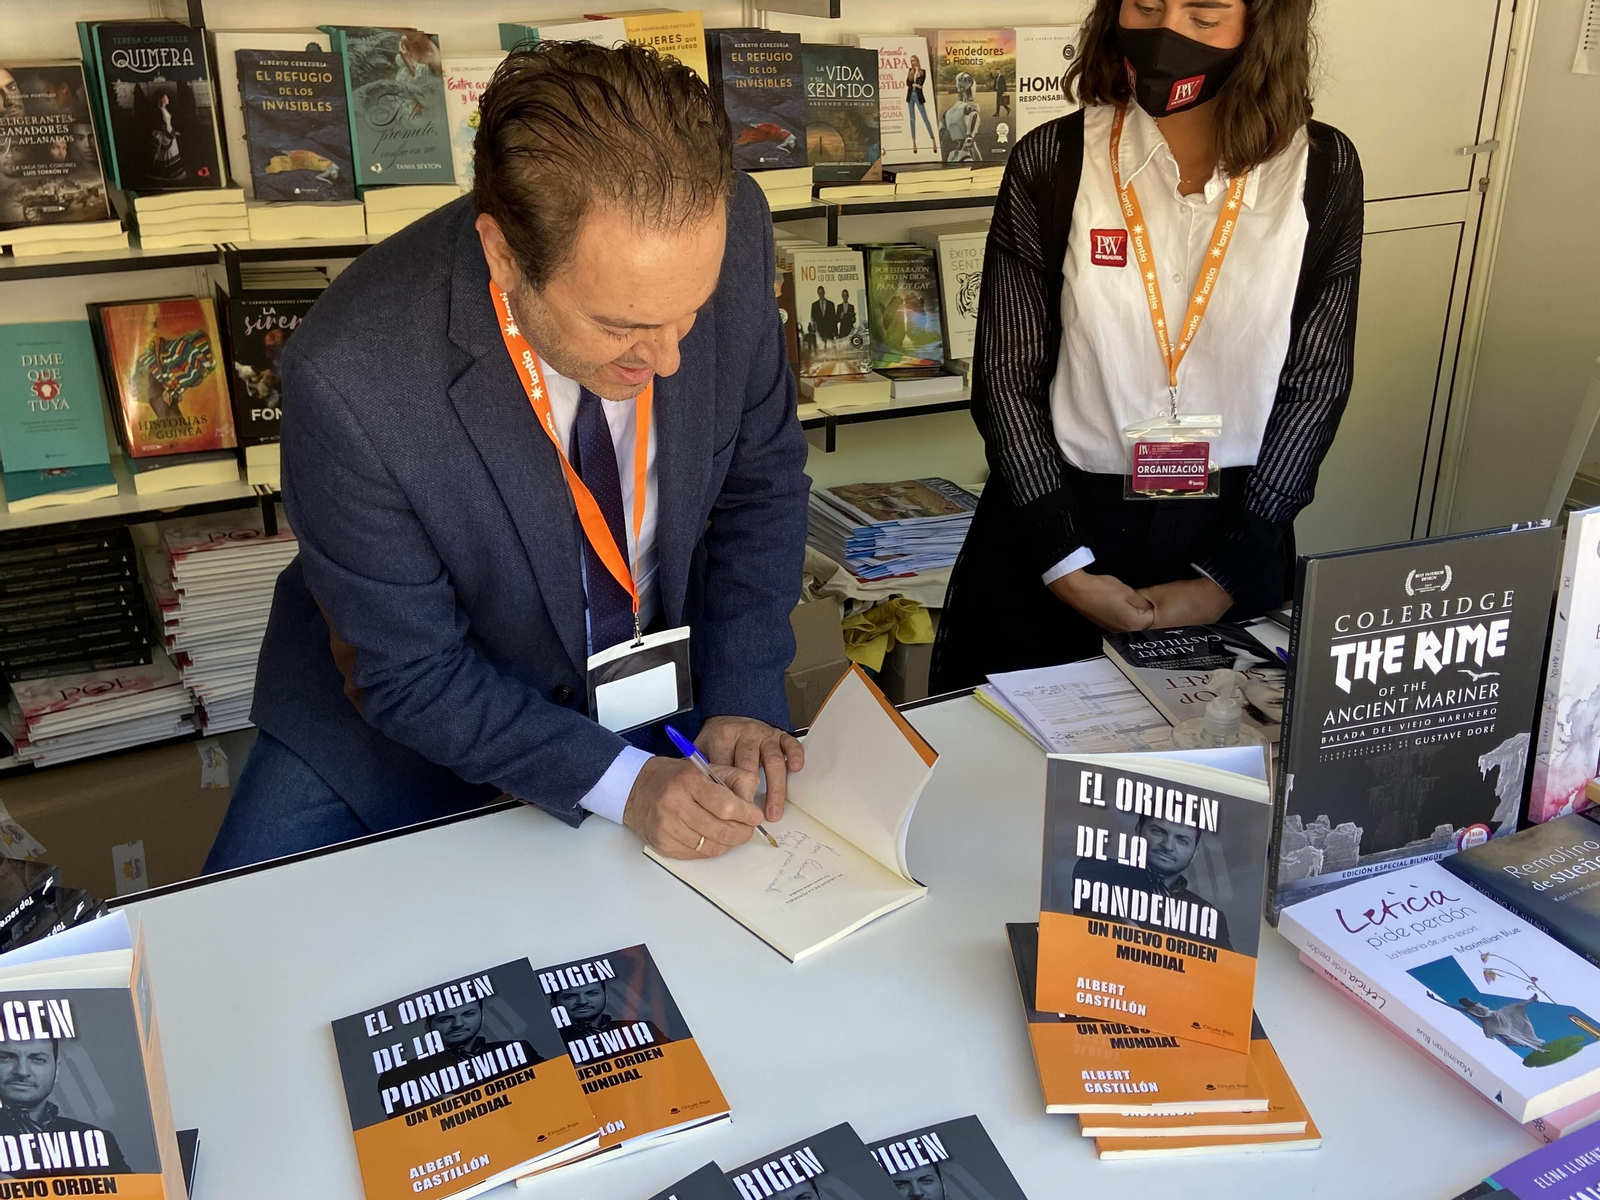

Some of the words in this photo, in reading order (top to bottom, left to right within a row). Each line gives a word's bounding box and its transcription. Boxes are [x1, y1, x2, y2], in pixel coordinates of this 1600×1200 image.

[113, 37, 143, 45] TERESA
[629, 34, 682, 45] MUJERES
[111, 48, 195, 73] QUIMERA
[731, 53, 744, 62] EL
[747, 52, 793, 62] REFUGIO
[945, 46, 1004, 56] Vendedores
[953, 57, 984, 65] Robots
[256, 71, 271, 81] EL
[275, 71, 333, 83] REFUGIO
[761, 66, 777, 74] LOS
[826, 65, 864, 81] VIDA
[879, 73, 894, 81] CON
[279, 87, 291, 96] DE
[294, 87, 313, 96] LOS
[447, 77, 473, 91] Entre
[736, 78, 793, 88] INVISIBLES
[807, 83, 874, 98] SENTIDO
[1019, 76, 1060, 93] HOM
[262, 100, 333, 112] INVISIBLES
[462, 94, 468, 105] y
[19, 135, 74, 145] APLANADOS
[1121, 191, 1134, 217] lantia
[1217, 219, 1233, 248] lantia
[1094, 235, 1124, 255] PW
[1134, 236, 1147, 263] lantia
[801, 265, 816, 281] NO
[827, 265, 857, 273] CONSEGUIR
[818, 274, 824, 282] LO
[825, 274, 835, 282] QUE
[838, 273, 859, 281] QUIERES
[1200, 267, 1217, 295] lantia
[897, 282, 913, 290] SOY
[914, 282, 930, 290] GAY
[1147, 283, 1158, 310] lantia
[262, 306, 277, 315] LA
[1184, 314, 1199, 342] lantia
[1158, 329, 1169, 357] lantia
[21, 353, 64, 367] DIME
[522, 349, 540, 387] lantia
[27, 368, 62, 383] QUE
[28, 399, 70, 412] TUYA
[139, 415, 208, 431] HISTORIAS
[156, 427, 204, 440] GUINEA
[1137, 464, 1205, 474] ORGANIZACIÓN
[1334, 589, 1515, 633] COLERIDGE
[1291, 605, 1299, 657] COLERIDGE
[1129, 635, 1222, 650] CASTILLÓN
[1138, 646, 1195, 658] ALBERT
[1330, 634, 1405, 694] THE
[1413, 618, 1510, 675] RIME
[1550, 656, 1560, 679] RAVEN
[1379, 685, 1396, 697] OF
[1402, 681, 1427, 693] THE
[1323, 697, 1409, 727] ANCIENT
[1415, 682, 1500, 711] MARINER
[1321, 729, 1366, 744] BALADA
[1373, 725, 1393, 736] DEL
[1400, 718, 1432, 731] VIEJO
[1438, 707, 1498, 724] MARINERO
[1415, 729, 1462, 746] GUSTAVE
[1467, 723, 1496, 738] DORÉ
[1079, 770, 1106, 807] EL
[1115, 777, 1219, 833] ORIGEN
[1076, 825, 1109, 861] DE
[1117, 833, 1148, 870] LA
[1342, 864, 1373, 879] EDICIÓN
[1374, 858, 1409, 873] ESPECIAL
[1410, 852, 1444, 867] BILINGÜE
[1502, 840, 1600, 879] Remolino
[1531, 881, 1554, 892] de
[1552, 889, 1580, 902] Karina
[20, 895, 34, 911] Top
[1073, 878, 1218, 940] PANDEMIA
[1335, 884, 1461, 934] Leticia
[1469, 881, 1508, 909] REMOLINO
[1509, 905, 1519, 916] DE
[1521, 912, 1550, 935] SUEÑOS
[1366, 927, 1411, 950] pide
[1409, 905, 1477, 935] perdón
[1087, 920, 1109, 938] UN
[1112, 924, 1163, 949] NUEVO
[1165, 934, 1218, 963] ORDEN
[1399, 942, 1428, 957] historia
[1427, 937, 1439, 946] de
[1440, 934, 1454, 943] una
[1455, 925, 1480, 938] escort
[1454, 932, 1503, 954] Maximilian
[1116, 945, 1186, 974] MUNDIAL
[538, 959, 616, 994] RIGEN
[1332, 961, 1347, 975] pide
[1348, 971, 1386, 1009] Leticia
[1076, 977, 1125, 997] ALBERT
[364, 1010, 393, 1037] EL
[398, 975, 494, 1025] ORIGEN
[1076, 991, 1147, 1017] CASTILLÓN
[1077, 1023, 1099, 1035] UN
[1222, 1028, 1235, 1037] Rojo
[372, 1042, 407, 1075] DE
[413, 1030, 445, 1060] LA
[1109, 1036, 1181, 1049] MUNDIAL
[614, 1047, 664, 1068] ORDEN
[1432, 1039, 1473, 1078] Maximilian
[381, 1041, 528, 1114] PANDEMIA
[1081, 1070, 1131, 1082] ALBERT
[1084, 1080, 1159, 1094] CASTILLÓN
[405, 1109, 429, 1127] UN
[431, 1090, 482, 1118] NUEVO
[484, 1068, 536, 1095] ORDEN
[439, 1094, 513, 1132] MUNDIAL
[409, 1151, 462, 1180] ALBERT
[412, 1153, 490, 1194] CASTILLÓN
[52, 1176, 118, 1196] ORDEN
[1533, 1167, 1569, 1189] ELENA
